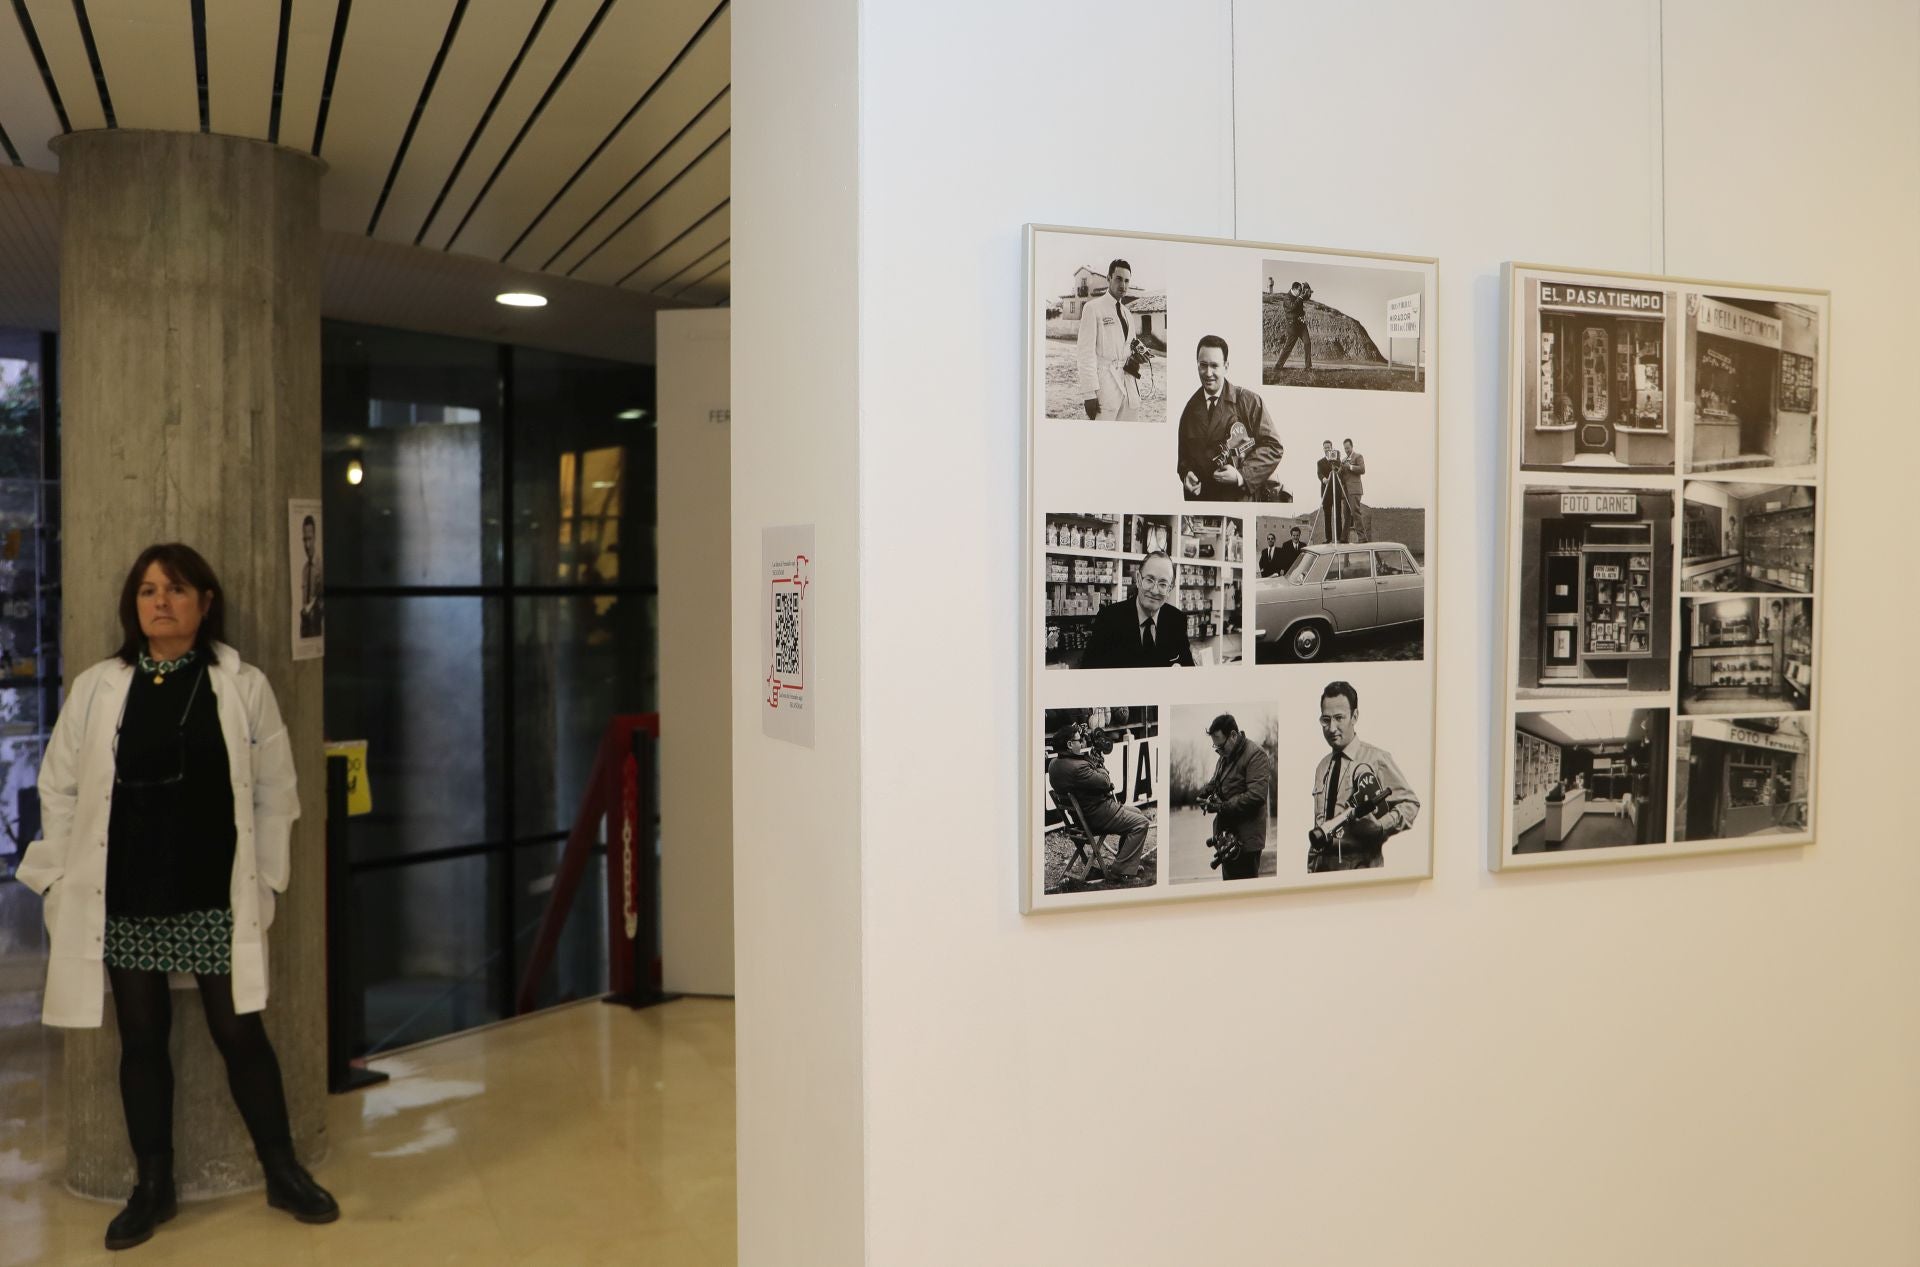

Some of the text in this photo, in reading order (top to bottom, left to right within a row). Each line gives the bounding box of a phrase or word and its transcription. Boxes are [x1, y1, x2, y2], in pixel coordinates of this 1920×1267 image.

[1541, 287, 1660, 309] EL PASATIEMPO
[1562, 496, 1636, 512] FOTO CARNET
[1731, 728, 1759, 743] FOTO
